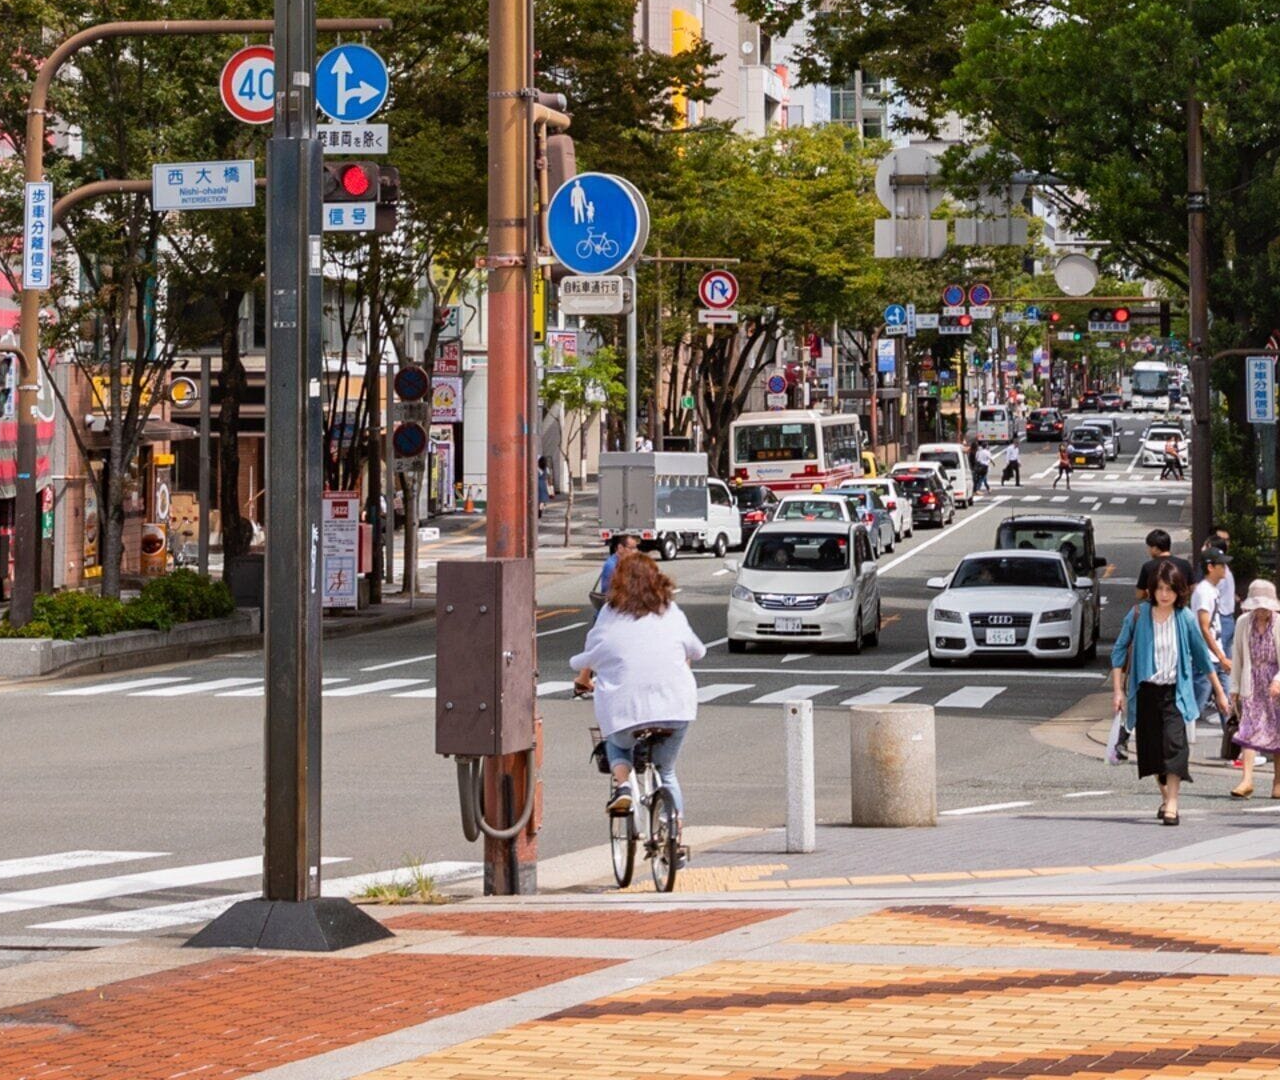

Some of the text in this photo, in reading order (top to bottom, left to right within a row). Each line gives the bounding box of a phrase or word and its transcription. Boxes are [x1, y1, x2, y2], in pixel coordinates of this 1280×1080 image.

[168, 167, 239, 185] 西大橋
[179, 186, 228, 196] Nishi-ohashi
[181, 195, 227, 204] INTERSECTION
[329, 208, 367, 224] 信号
[564, 281, 620, 294] 自転車通行可
